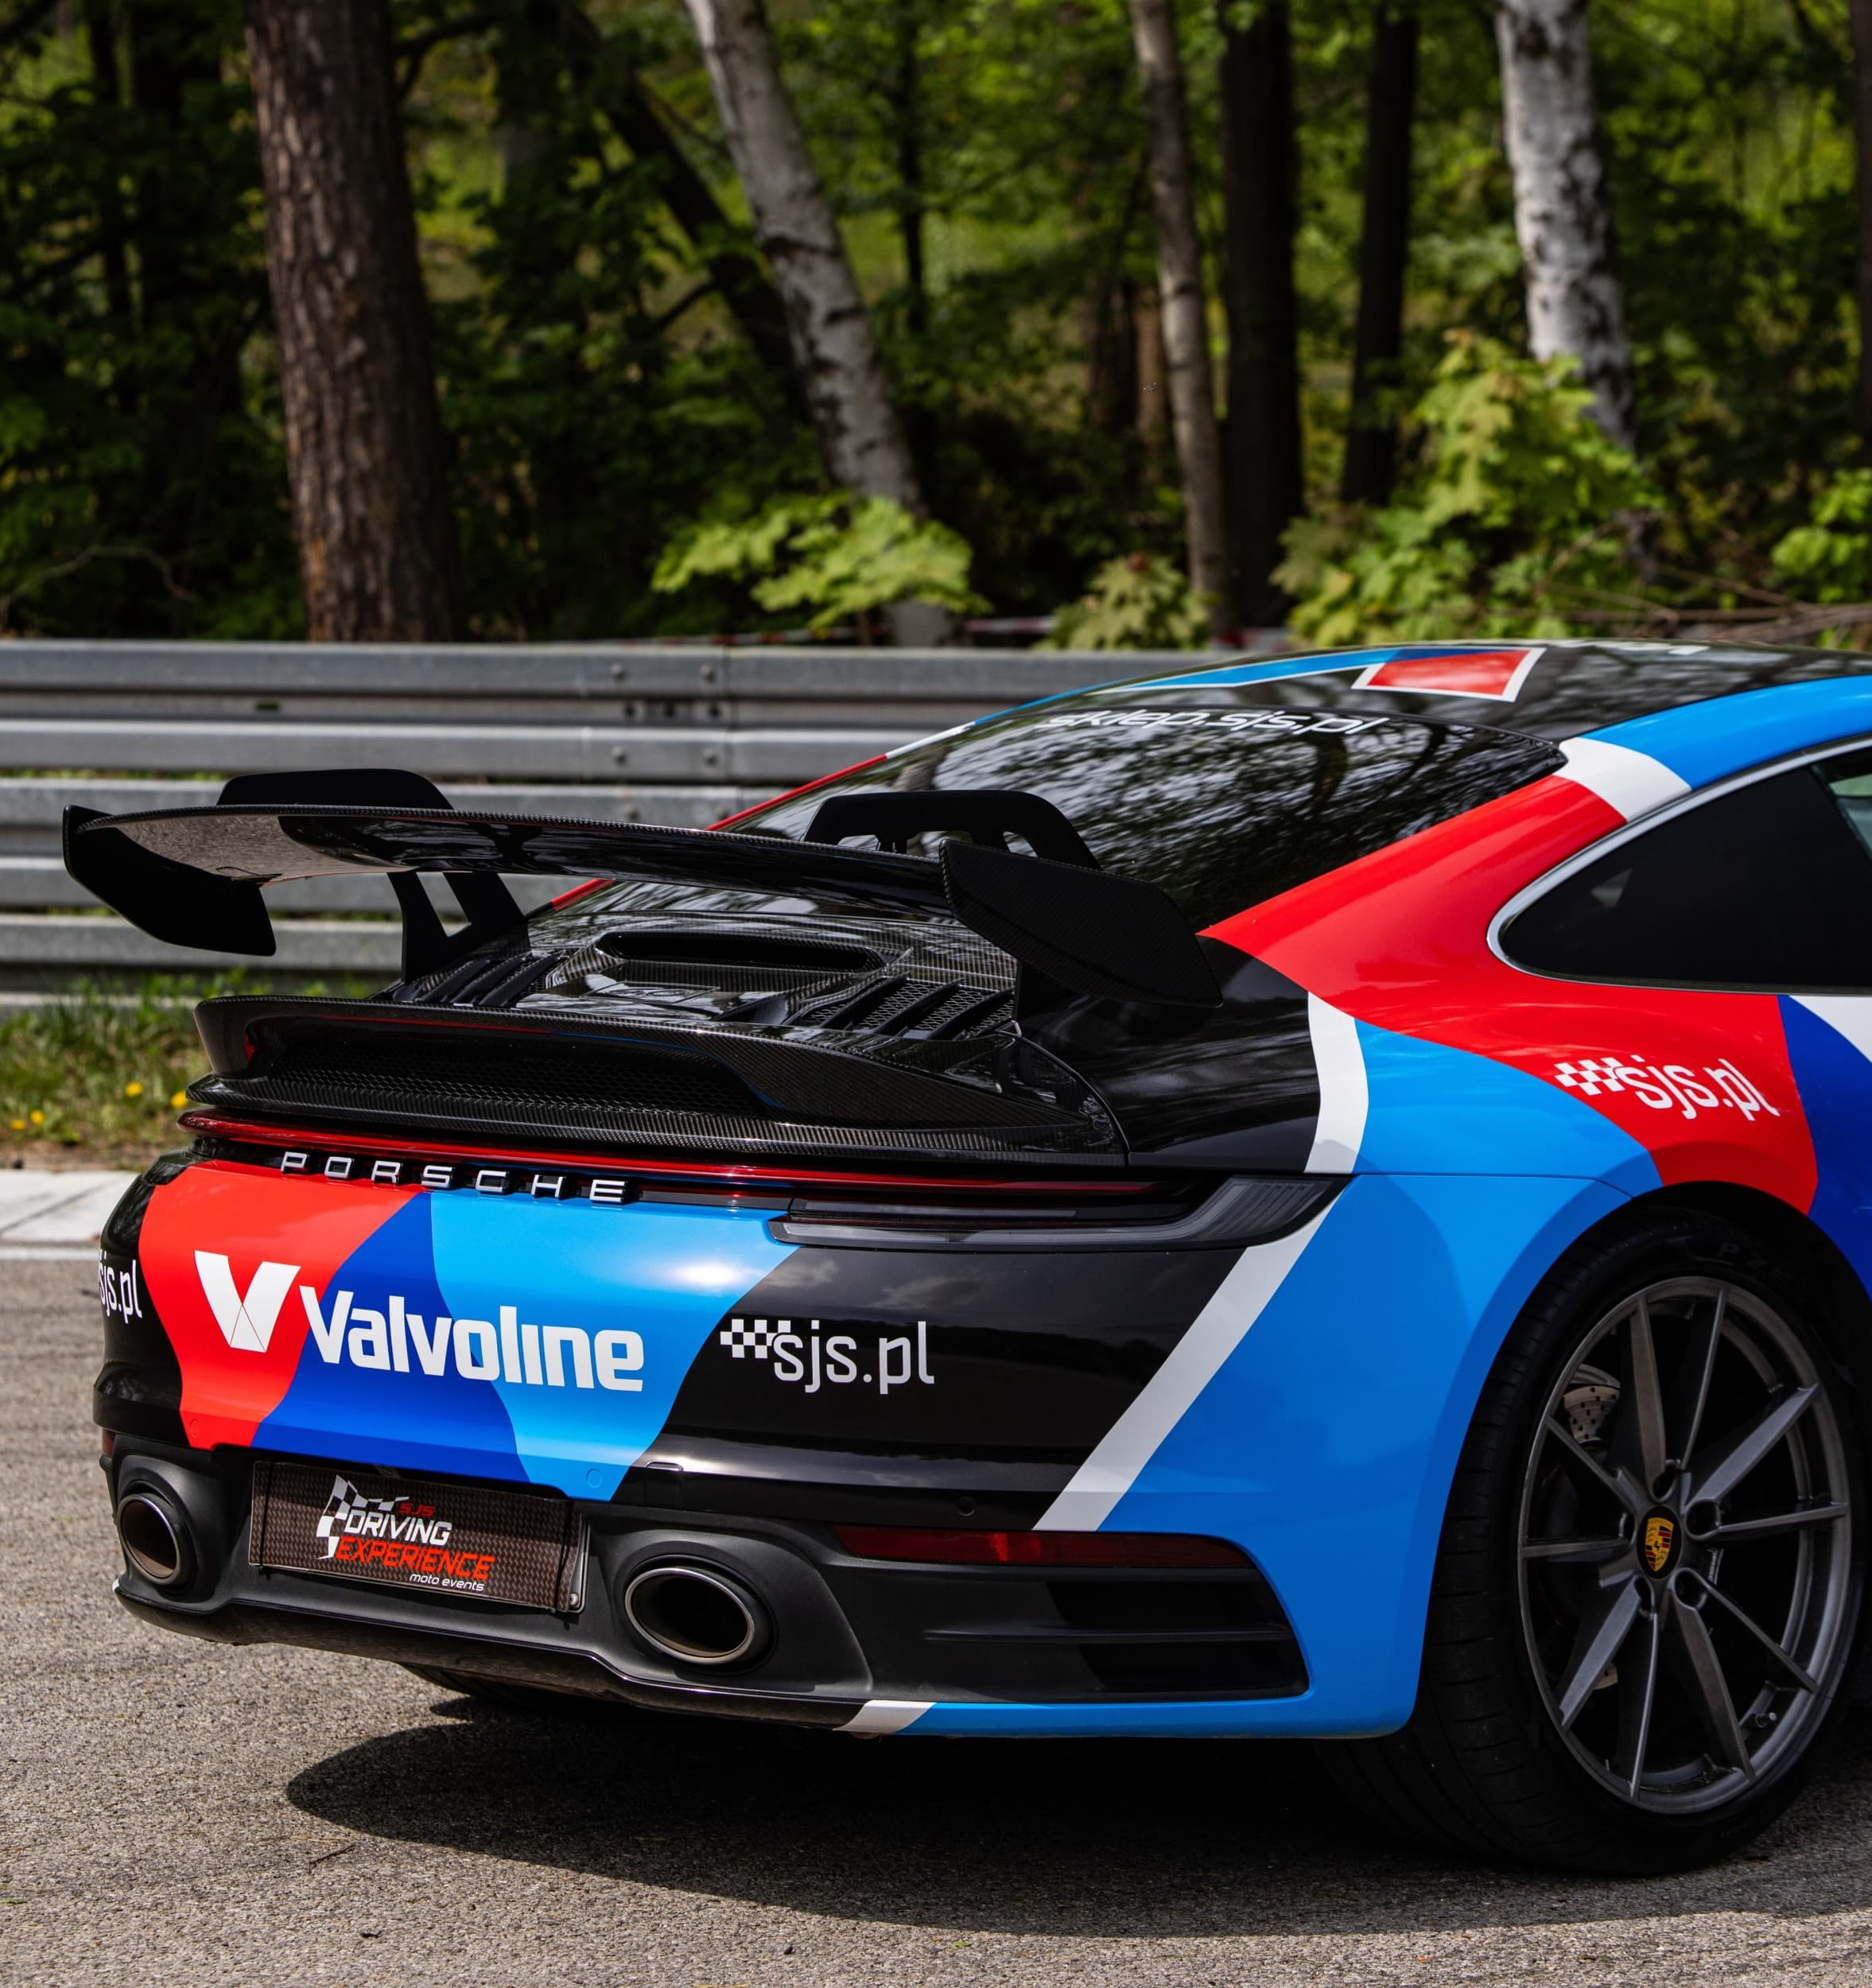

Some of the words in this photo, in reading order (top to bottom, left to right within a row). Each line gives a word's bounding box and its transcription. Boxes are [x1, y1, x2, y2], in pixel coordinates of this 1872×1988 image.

[1035, 709, 1389, 735] sklep.sjs.pl
[1613, 1054, 1781, 1121] sjs.pl
[280, 1151, 627, 1204] PORSCHE
[298, 1285, 645, 1392] Valvoline
[773, 1319, 934, 1395] sjs.pl
[344, 1510, 452, 1546] DRIVING
[398, 1502, 437, 1518] SJS
[335, 1536, 496, 1581] EXPERIENCE
[409, 1573, 440, 1586] moto
[441, 1578, 485, 1591] events
